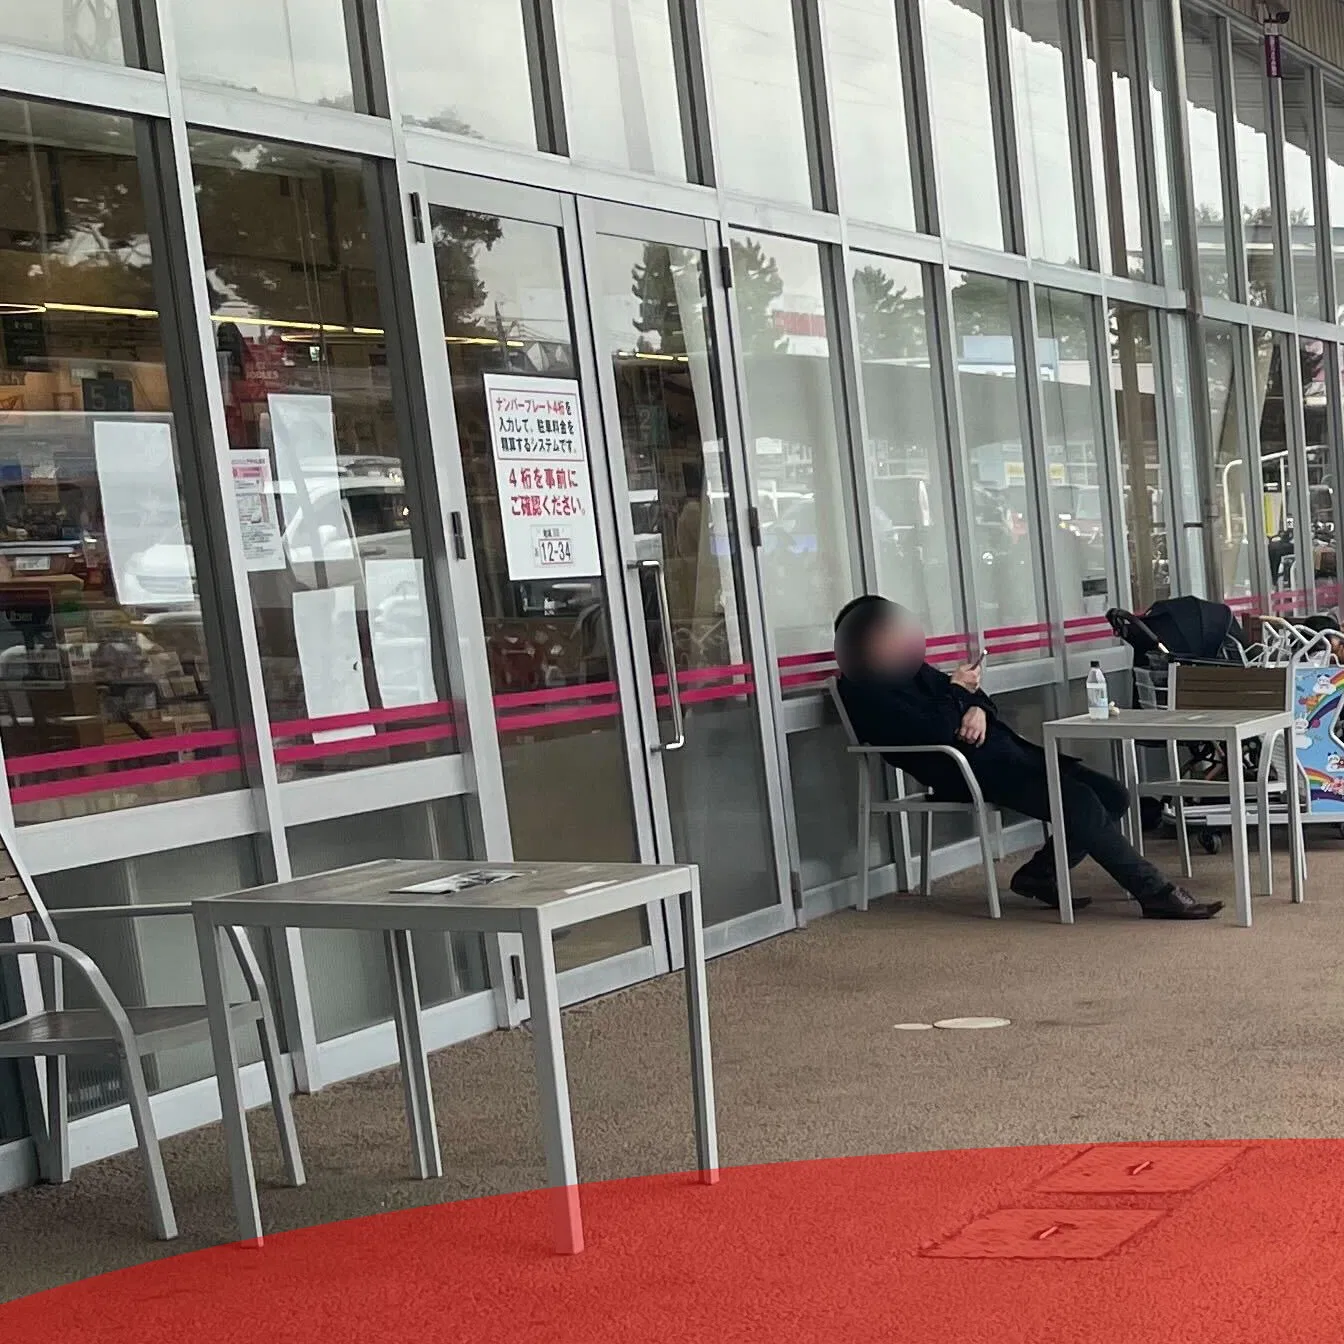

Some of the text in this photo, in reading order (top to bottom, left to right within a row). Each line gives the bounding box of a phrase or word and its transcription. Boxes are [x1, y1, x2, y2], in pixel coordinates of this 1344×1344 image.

[510, 495, 586, 516] ご確認ください。
[541, 540, 571, 562] 12-34
